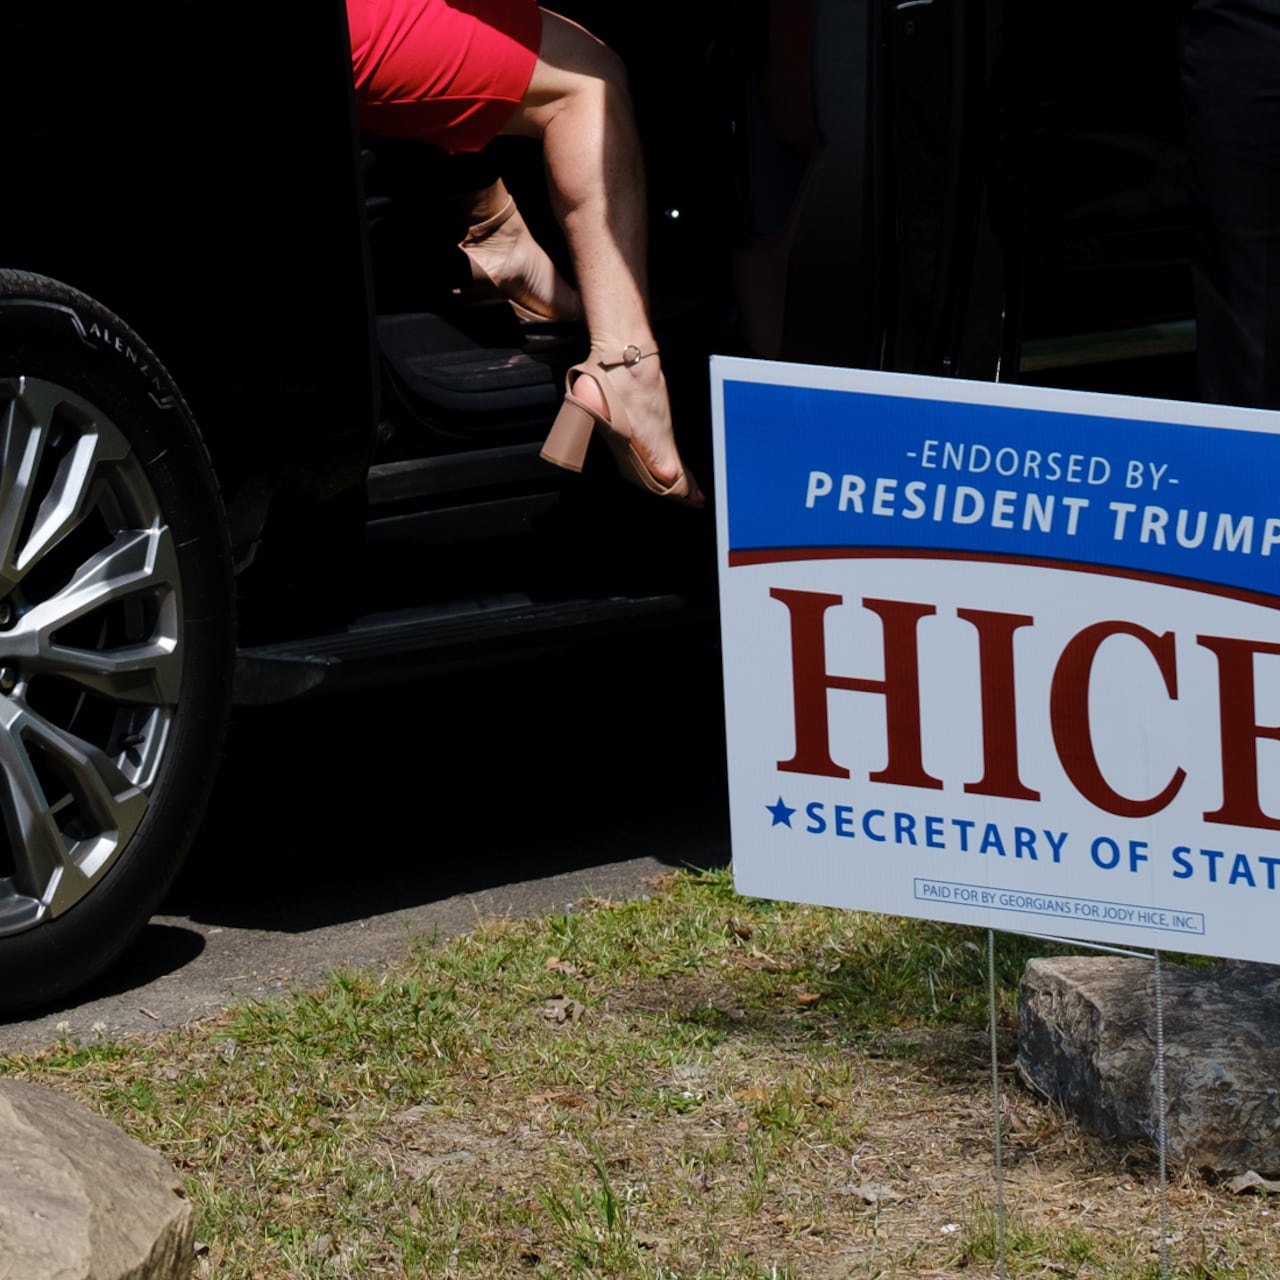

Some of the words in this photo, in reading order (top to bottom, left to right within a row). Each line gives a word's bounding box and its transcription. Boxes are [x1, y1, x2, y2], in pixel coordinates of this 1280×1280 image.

[804, 471, 1089, 535] PRESIDENT
[805, 800, 1069, 864] SECRETARY
[1090, 836, 1150, 874] OF
[923, 883, 951, 898] PAID
[954, 888, 979, 902] FOR
[981, 891, 997, 904] BY
[999, 893, 1071, 914] GEORGIANS
[1074, 903, 1100, 917] FOR
[1101, 906, 1135, 922] JODY
[1138, 911, 1169, 927] HICE,
[1172, 916, 1197, 930] INC.
